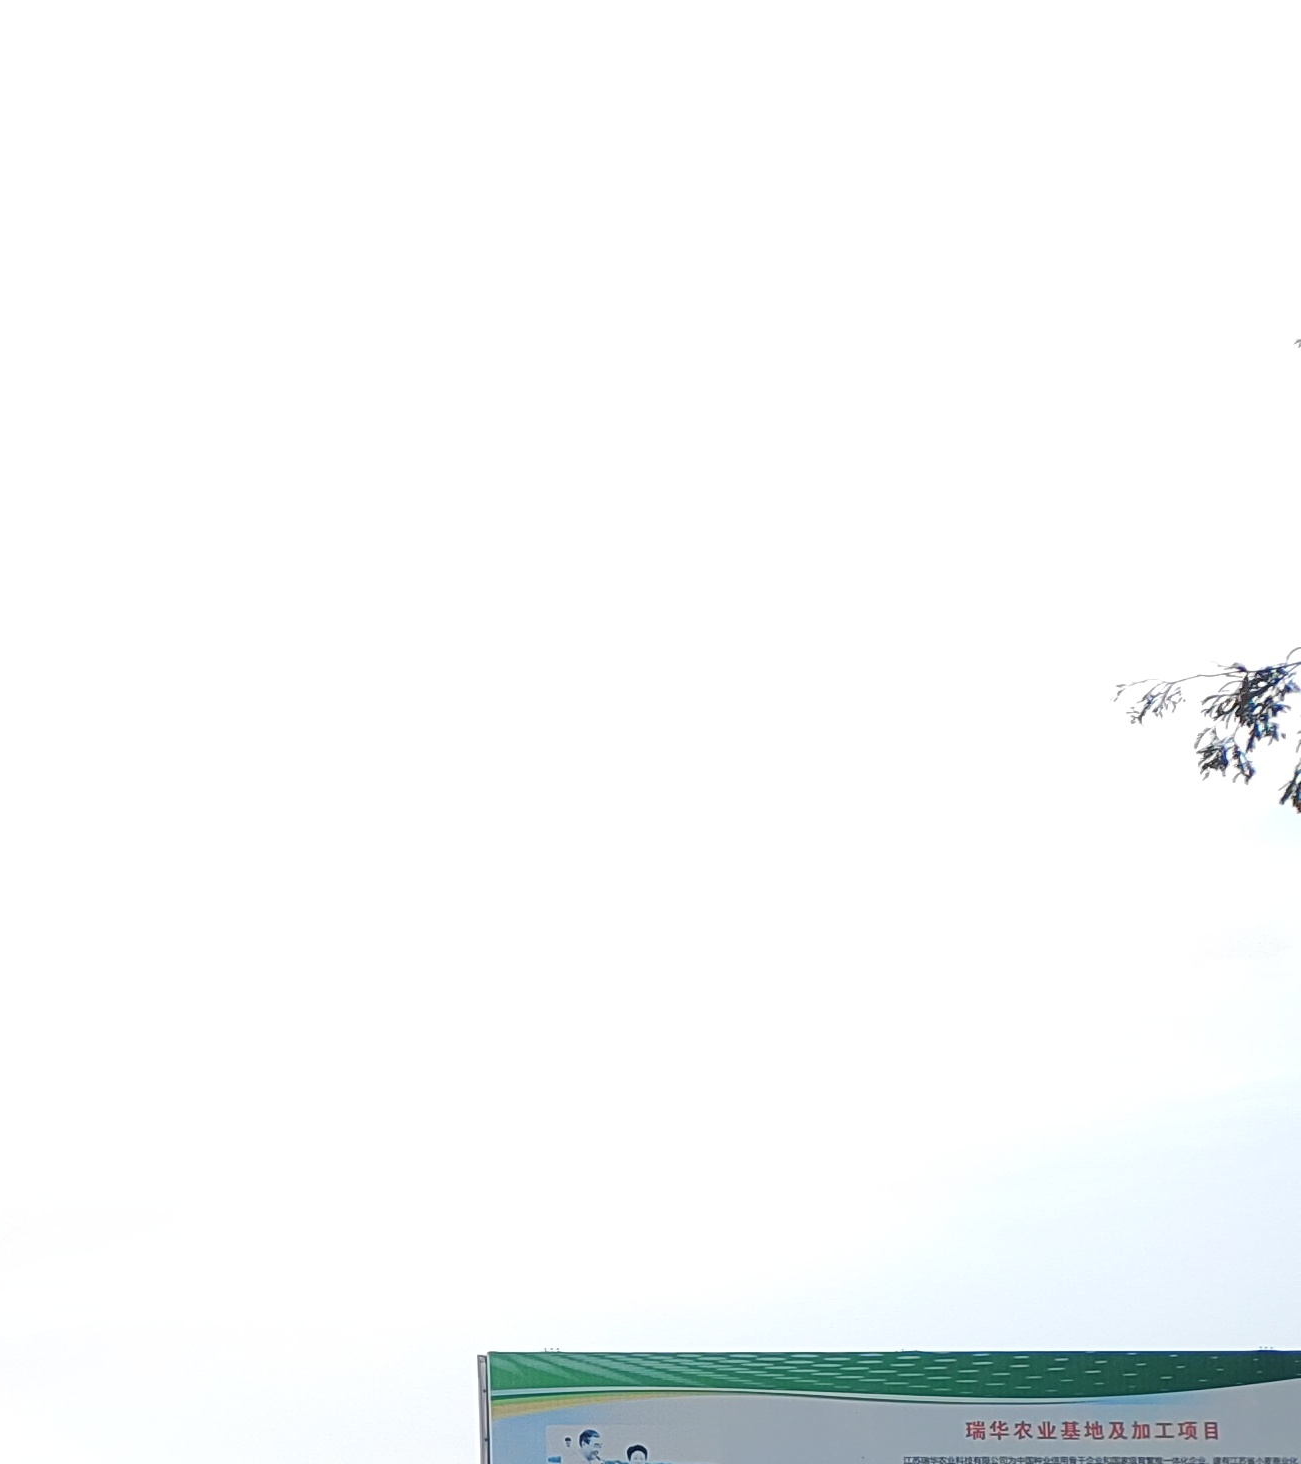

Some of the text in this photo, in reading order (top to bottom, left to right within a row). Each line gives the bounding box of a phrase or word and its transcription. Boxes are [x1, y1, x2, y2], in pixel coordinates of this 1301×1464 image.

[965, 1420, 1220, 1441] 瑞华农业基地及加工项目
